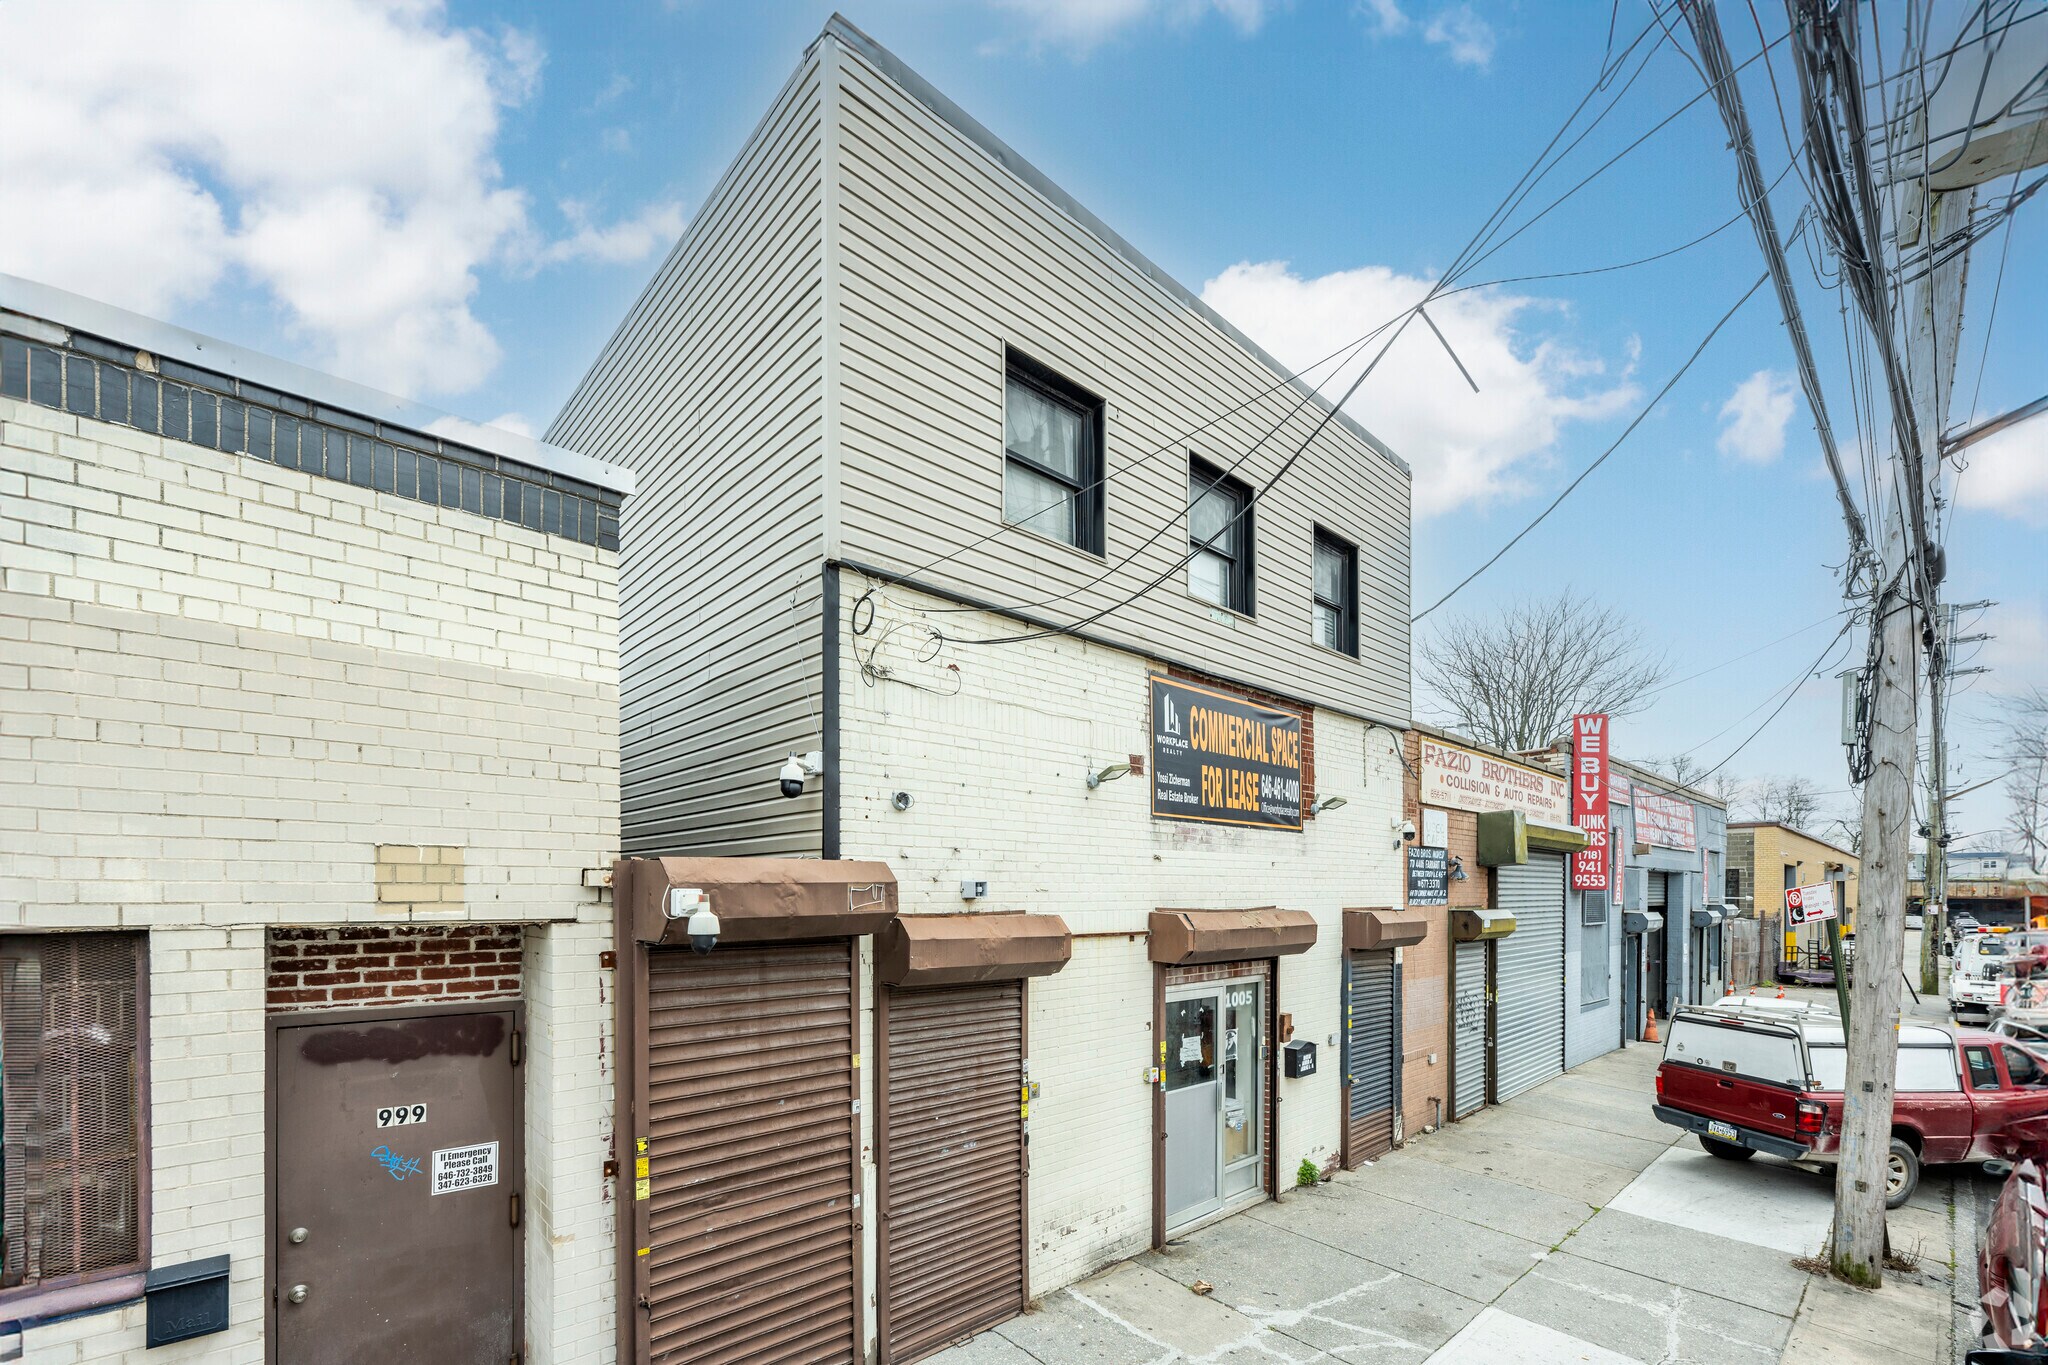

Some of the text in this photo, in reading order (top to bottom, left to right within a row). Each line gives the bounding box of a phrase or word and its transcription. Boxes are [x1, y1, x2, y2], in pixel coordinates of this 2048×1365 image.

[1157, 734, 1188, 749] WORKPLACE
[1190, 705, 1299, 769] COMMERCIAL SPACE
[1579, 718, 1603, 752] WE
[1163, 747, 1183, 756] REALTY
[1424, 744, 1471, 774] FAZIO
[1482, 760, 1544, 793] BROTHERS
[1201, 765, 1259, 812] FOR LEASE
[1446, 774, 1490, 795] COLLISION
[1494, 785, 1500, 797] &
[1504, 787, 1523, 803] AUTO
[1527, 793, 1553, 809] REPAIRS
[1581, 757, 1600, 810] BUY
[1157, 788, 1199, 804] Real Estate Broker
[1576, 814, 1606, 829] JUNK
[1578, 849, 1602, 860] (718)
[1578, 861, 1602, 873] 941
[1575, 874, 1606, 887] 9553
[1226, 990, 1253, 1008] 1005
[378, 1105, 425, 1127] 999
[440, 1147, 492, 1162] If Emergency
[444, 1155, 488, 1170] Please Call
[438, 1165, 493, 1181] 646-732-3849
[438, 1174, 493, 1190] 347-623-6326
[165, 1311, 211, 1334] Mail
